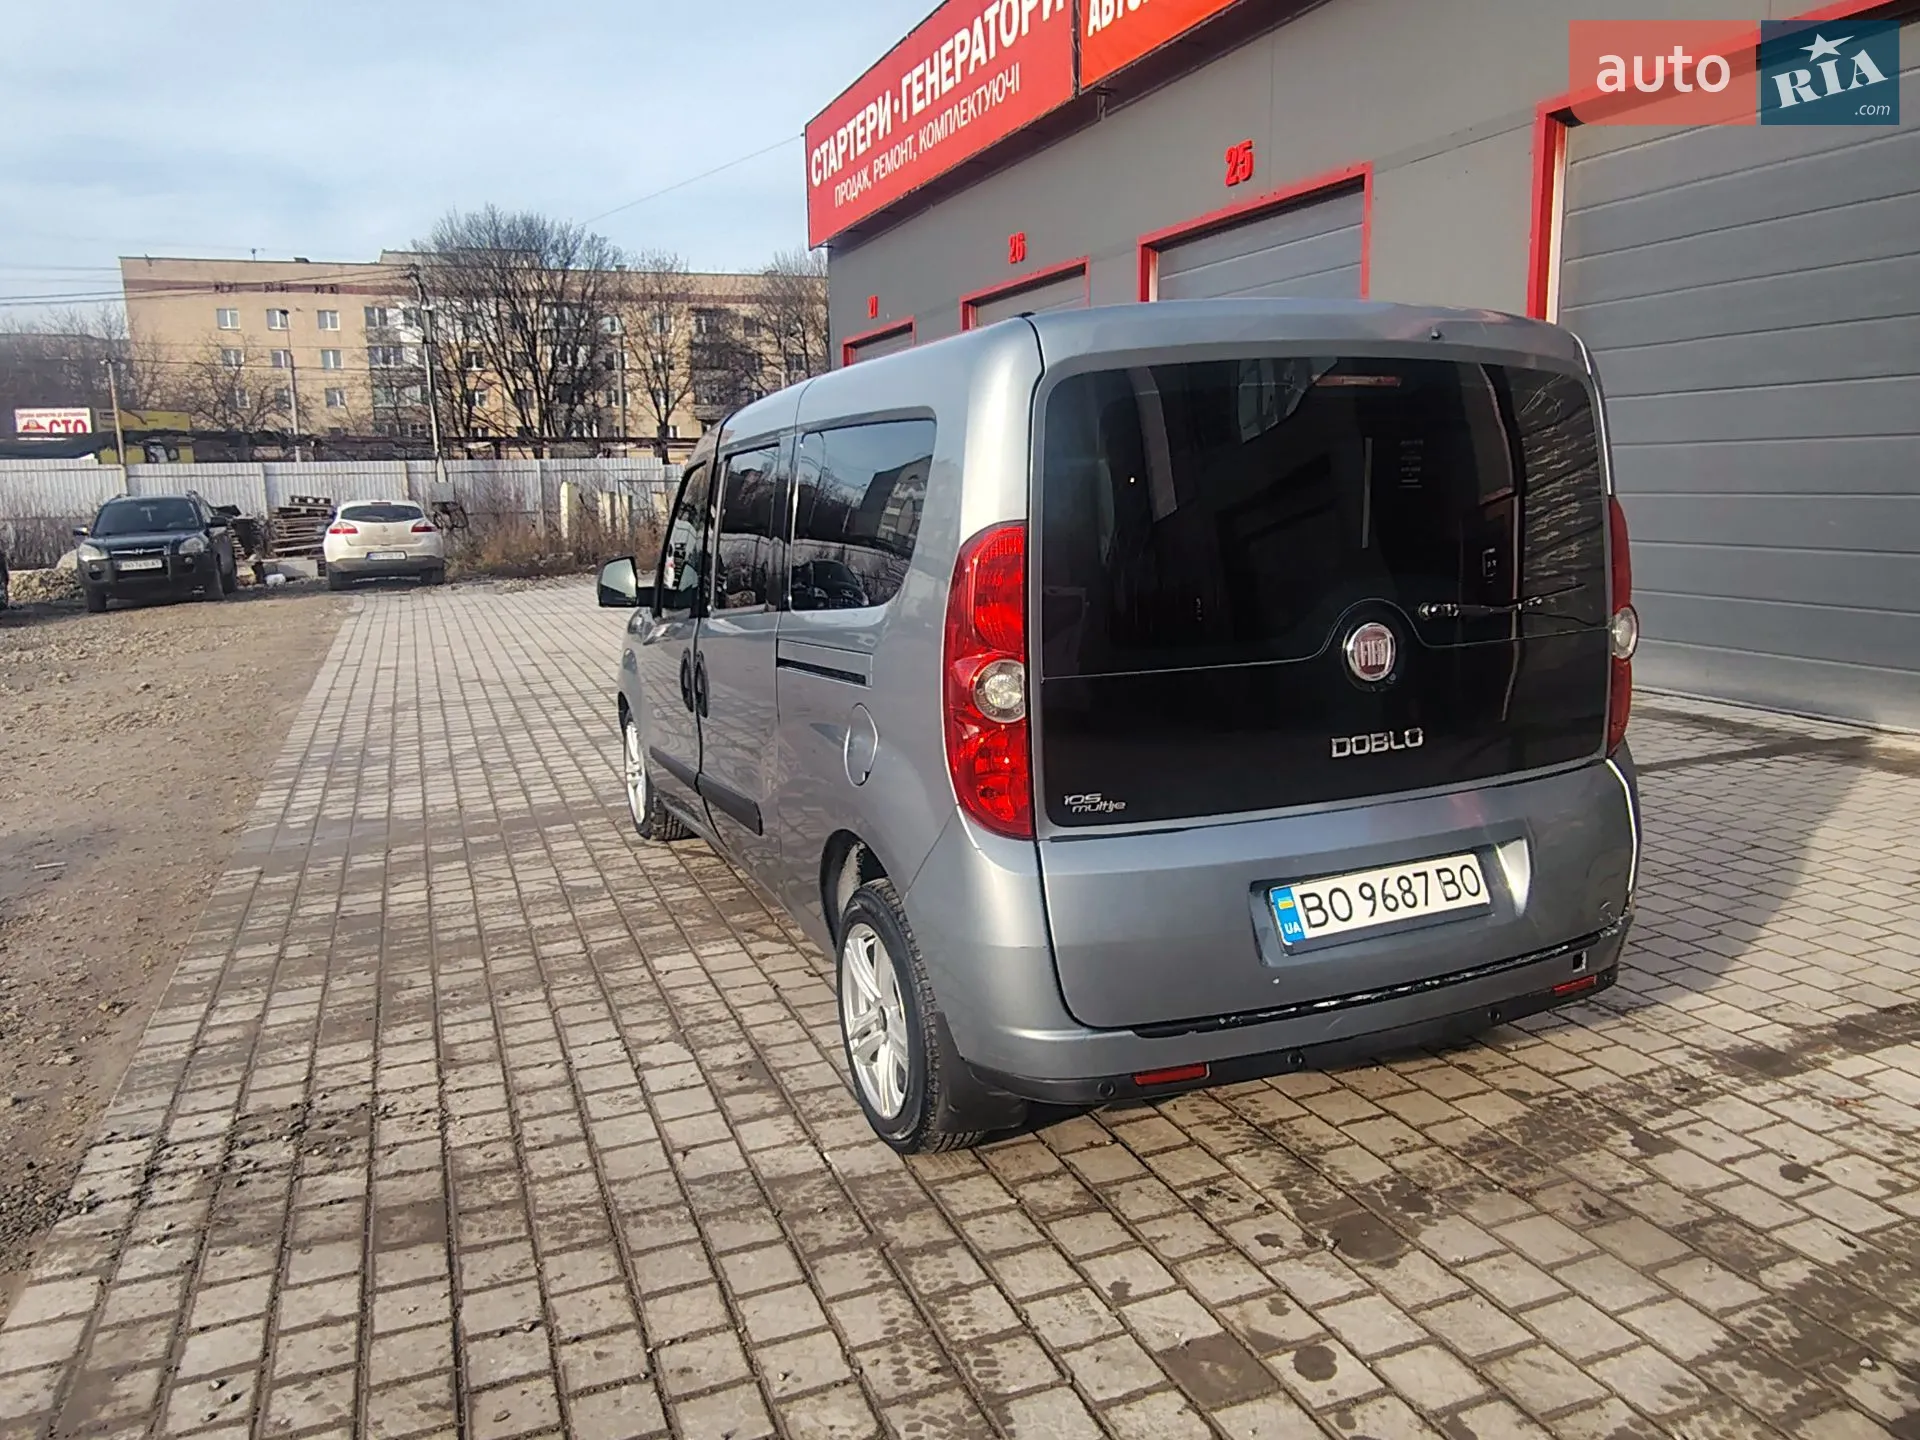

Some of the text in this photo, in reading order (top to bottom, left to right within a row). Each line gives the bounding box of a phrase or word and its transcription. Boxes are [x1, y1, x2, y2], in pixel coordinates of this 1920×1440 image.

[834, 62, 1020, 208] ПРОДАЖ, РЕМОНТ, КОМПЛЕКТУЮЧІ
[1224, 138, 1254, 188] 25
[1008, 232, 1026, 264] 26
[1331, 727, 1424, 757] DOBLO
[1299, 863, 1482, 929] BO 9687 BO
[1284, 921, 1302, 935] UA
